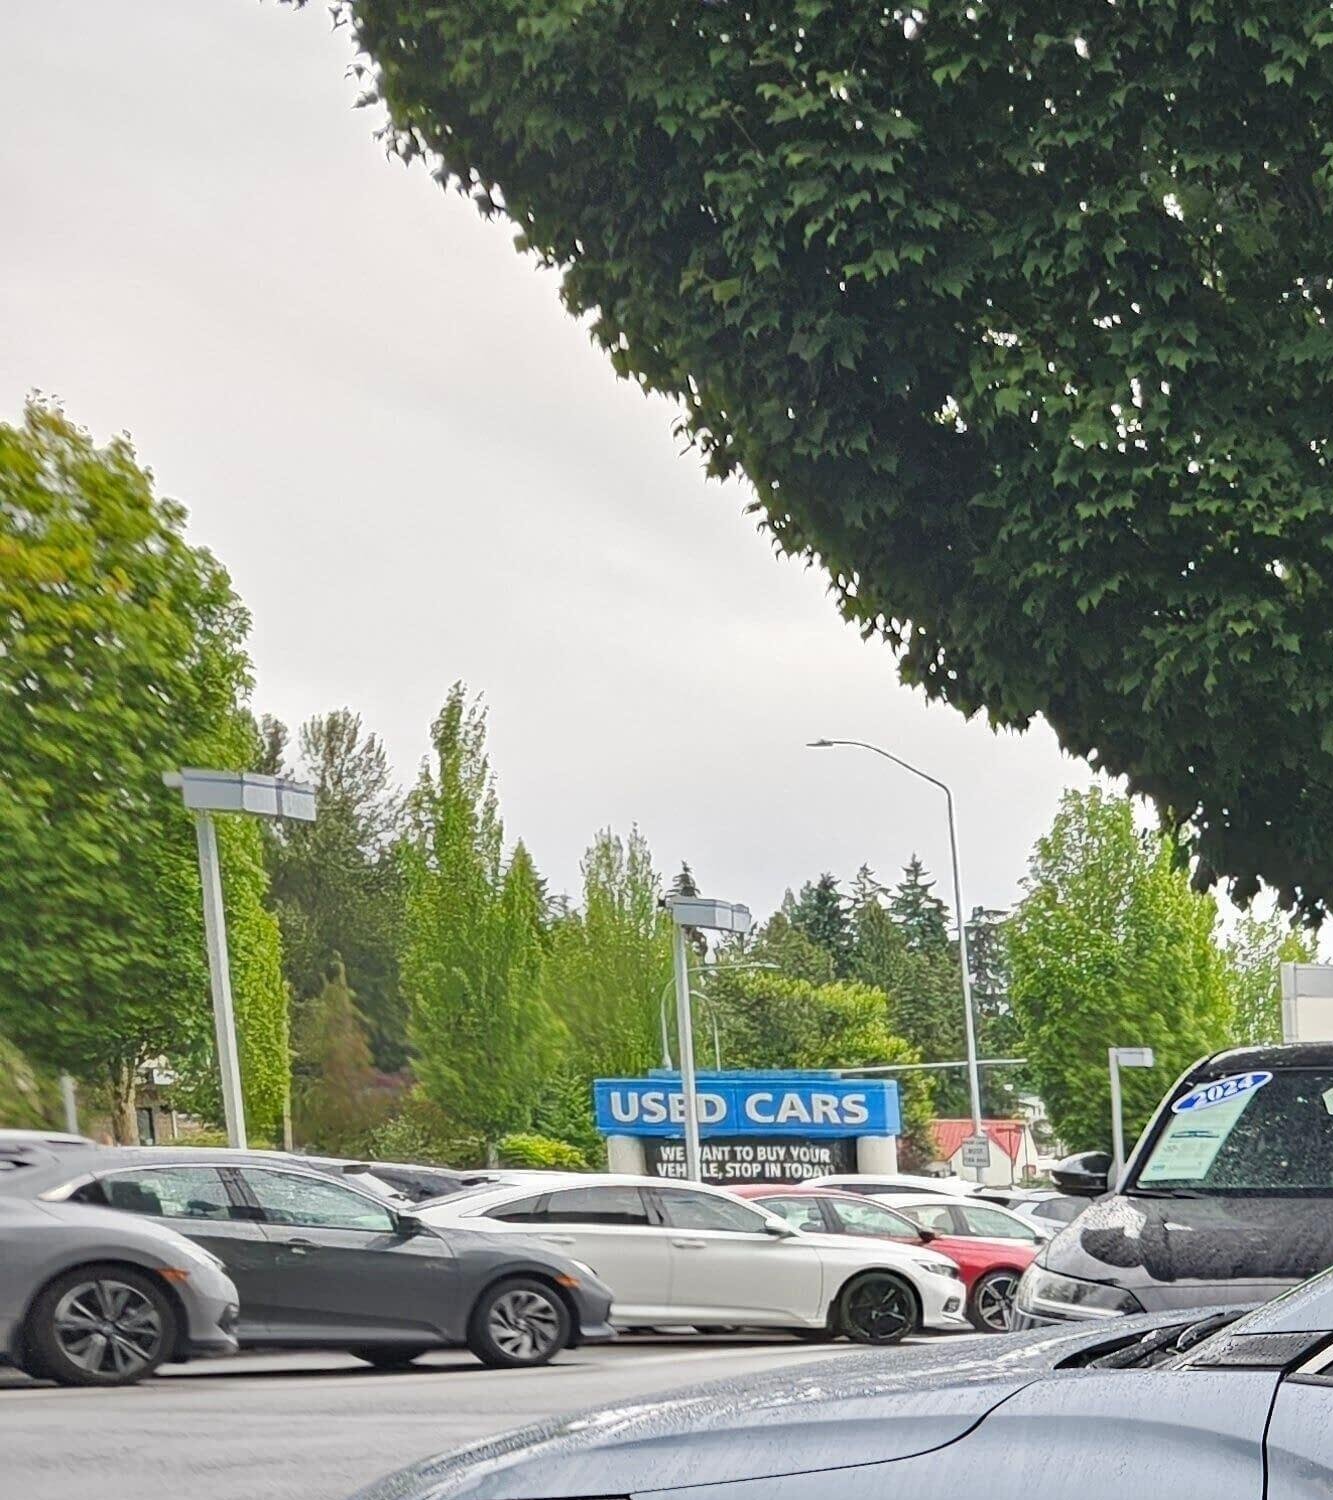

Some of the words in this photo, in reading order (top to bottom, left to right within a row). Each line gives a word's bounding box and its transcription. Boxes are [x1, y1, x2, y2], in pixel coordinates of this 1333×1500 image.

[1194, 1076, 1254, 1106] 2024
[610, 1091, 727, 1124] USED
[745, 1092, 869, 1125] CARS
[660, 1146, 685, 1161] WE
[697, 1146, 731, 1161] ANT
[734, 1146, 754, 1161] TO
[757, 1146, 786, 1161] BUY
[789, 1146, 831, 1163] YOUR
[656, 1163, 723, 1180] VEHLE,
[725, 1163, 761, 1178] STOP
[765, 1163, 781, 1178] IN
